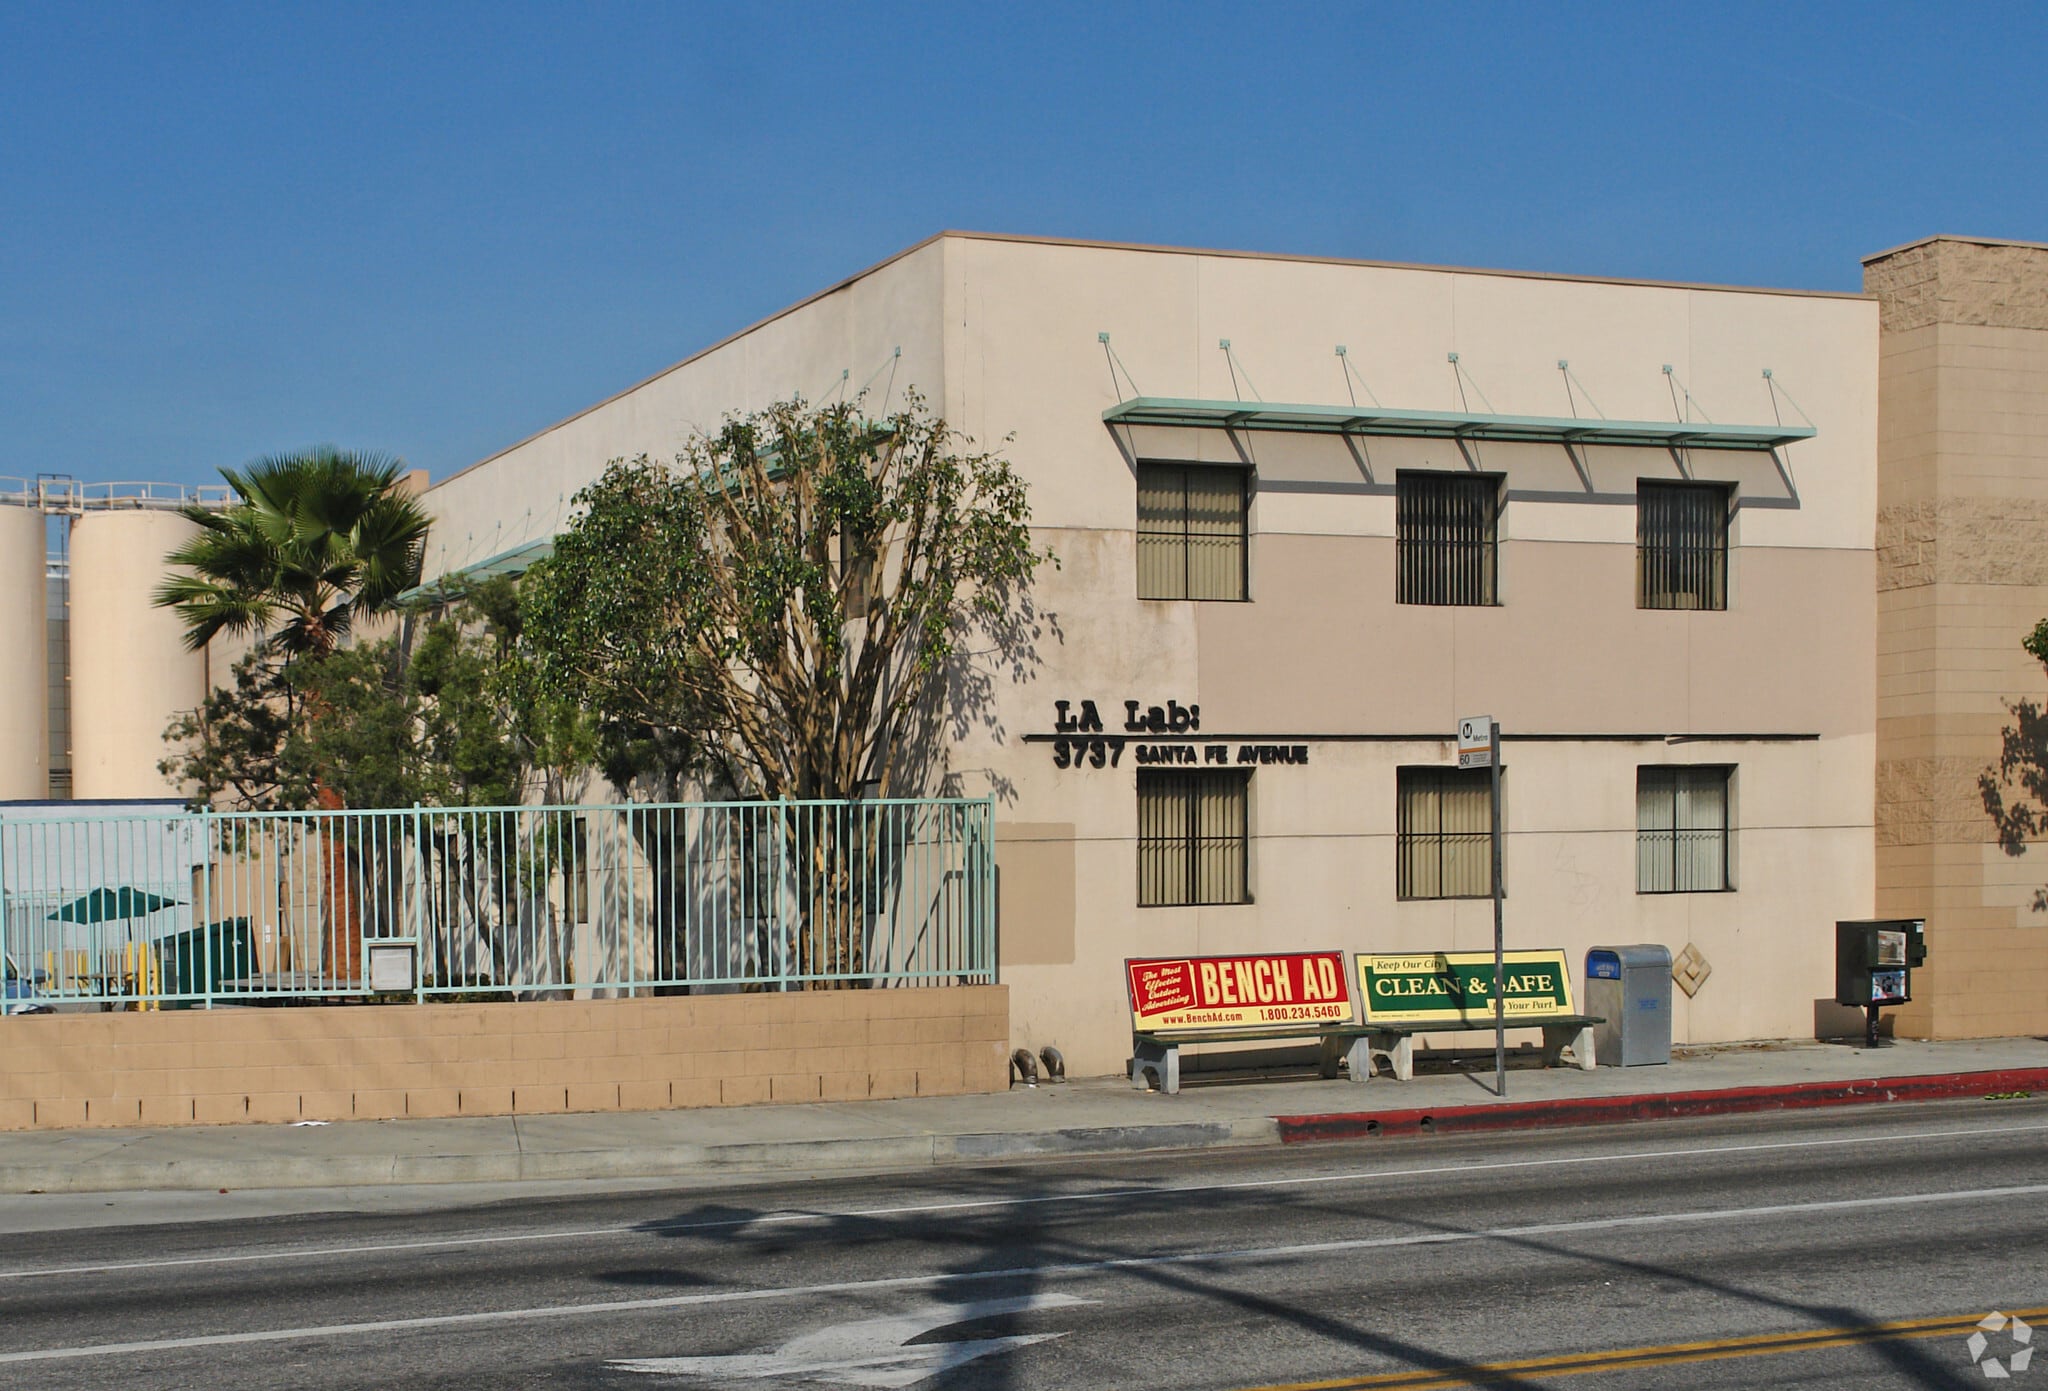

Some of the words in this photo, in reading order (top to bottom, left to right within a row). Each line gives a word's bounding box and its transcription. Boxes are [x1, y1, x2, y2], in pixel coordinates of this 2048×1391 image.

[1054, 700, 1103, 733] LA
[1135, 745, 1197, 765] SANTA
[1204, 745, 1229, 765] FE
[1237, 745, 1309, 765] AVENUE
[1459, 754, 1470, 765] 60
[1376, 960, 1401, 972] Keep
[1402, 960, 1421, 969] Our
[1423, 959, 1443, 970] City
[1142, 971, 1158, 982] The
[1161, 966, 1182, 977] Most
[1199, 957, 1293, 1005] BENCH
[1303, 957, 1339, 1001] AD
[1145, 977, 1182, 991] Effective
[1375, 976, 1460, 997] CLEAN
[1468, 977, 1488, 994] &
[1148, 987, 1181, 1000] Outdoor
[1141, 995, 1190, 1012] Advertising
[1508, 1001, 1530, 1010] Your
[1532, 1000, 1552, 1009] Part
[1162, 1011, 1243, 1025] www.BenchAd.com
[1260, 1005, 1341, 1022] 1.800.234.5460
